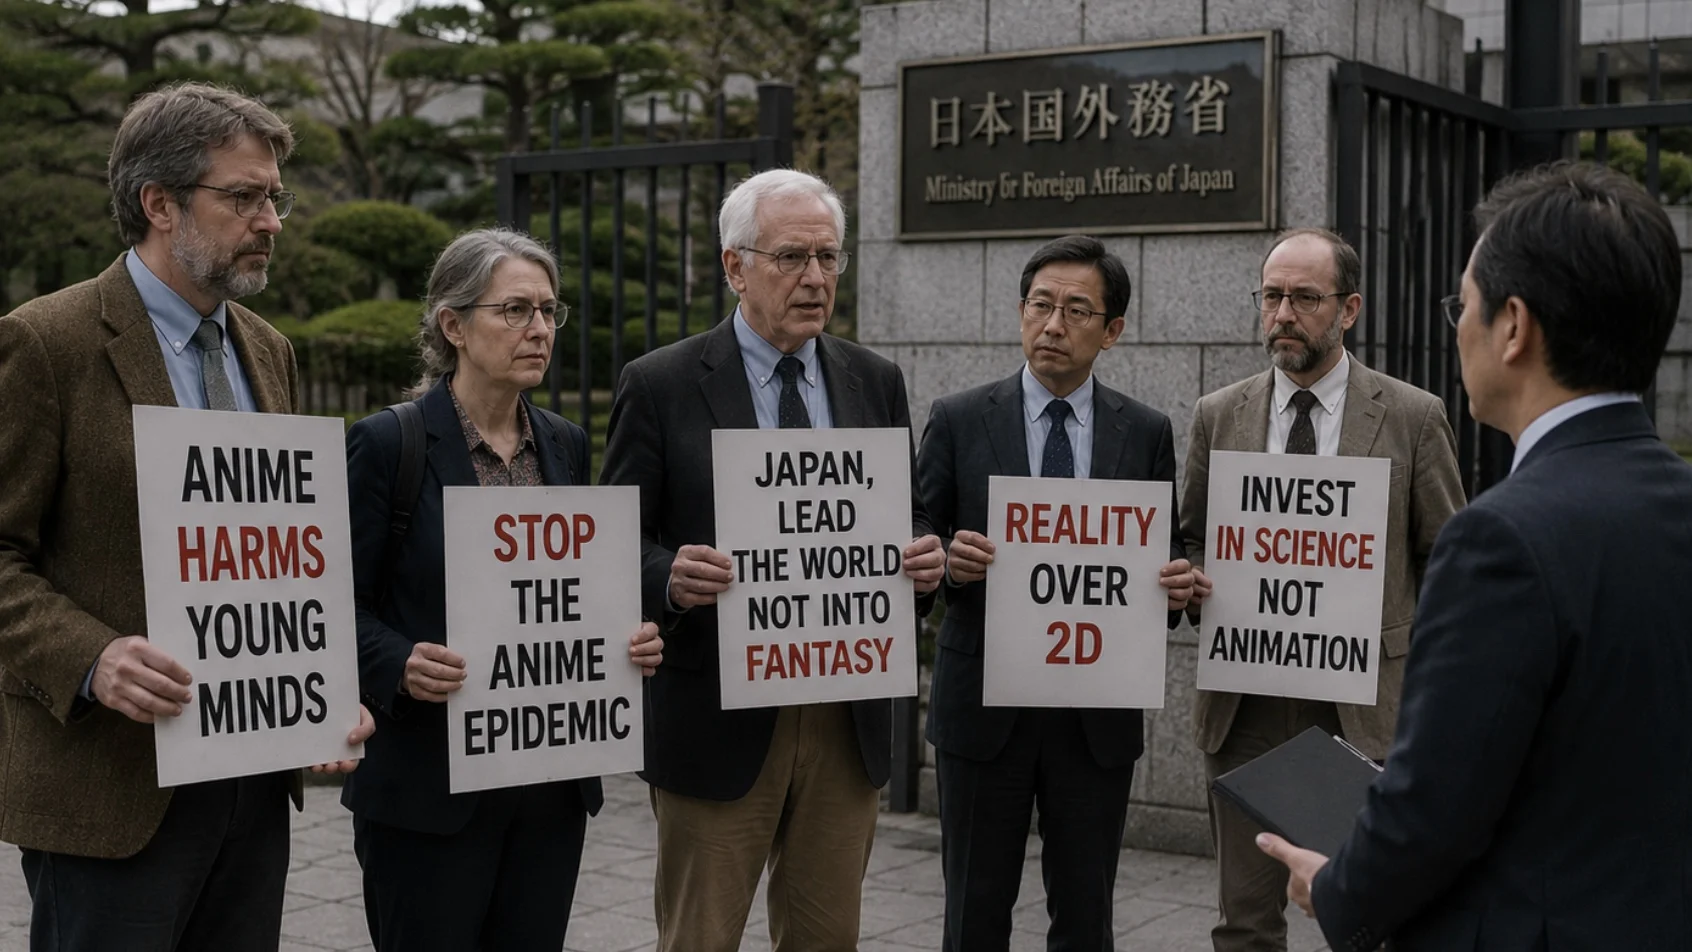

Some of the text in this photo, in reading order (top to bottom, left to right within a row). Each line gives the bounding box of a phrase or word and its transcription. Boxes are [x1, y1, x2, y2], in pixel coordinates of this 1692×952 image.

[930, 75, 1230, 149] 日本国外務省
[924, 173, 997, 206] Ministry
[1022, 170, 1086, 203] Foreign
[1092, 166, 1153, 195] Affairs
[1156, 163, 1177, 192] of
[1179, 163, 1235, 196] Japan
[181, 446, 316, 504] ANIME
[754, 450, 875, 490] JAPAN,
[778, 499, 857, 534] LEAD
[1240, 475, 1356, 518] INVEST
[493, 513, 597, 563] STOP
[1005, 502, 1158, 547] REALITY
[177, 525, 326, 583] HARMS
[731, 544, 902, 584] THE WORLD
[1215, 525, 1375, 570] IN SCIENCE
[510, 577, 582, 625] THE
[1029, 562, 1129, 607] OVER
[1258, 577, 1324, 618] NOT
[185, 598, 327, 661] YOUNG
[748, 590, 891, 631] NOT INTO
[488, 637, 606, 691] ANIME
[746, 637, 894, 682] FANTASY
[1045, 620, 1103, 665] 2D
[1208, 625, 1369, 673] ANIMATION
[198, 671, 328, 737] MINDS
[464, 696, 631, 757] EPIDEMIC
